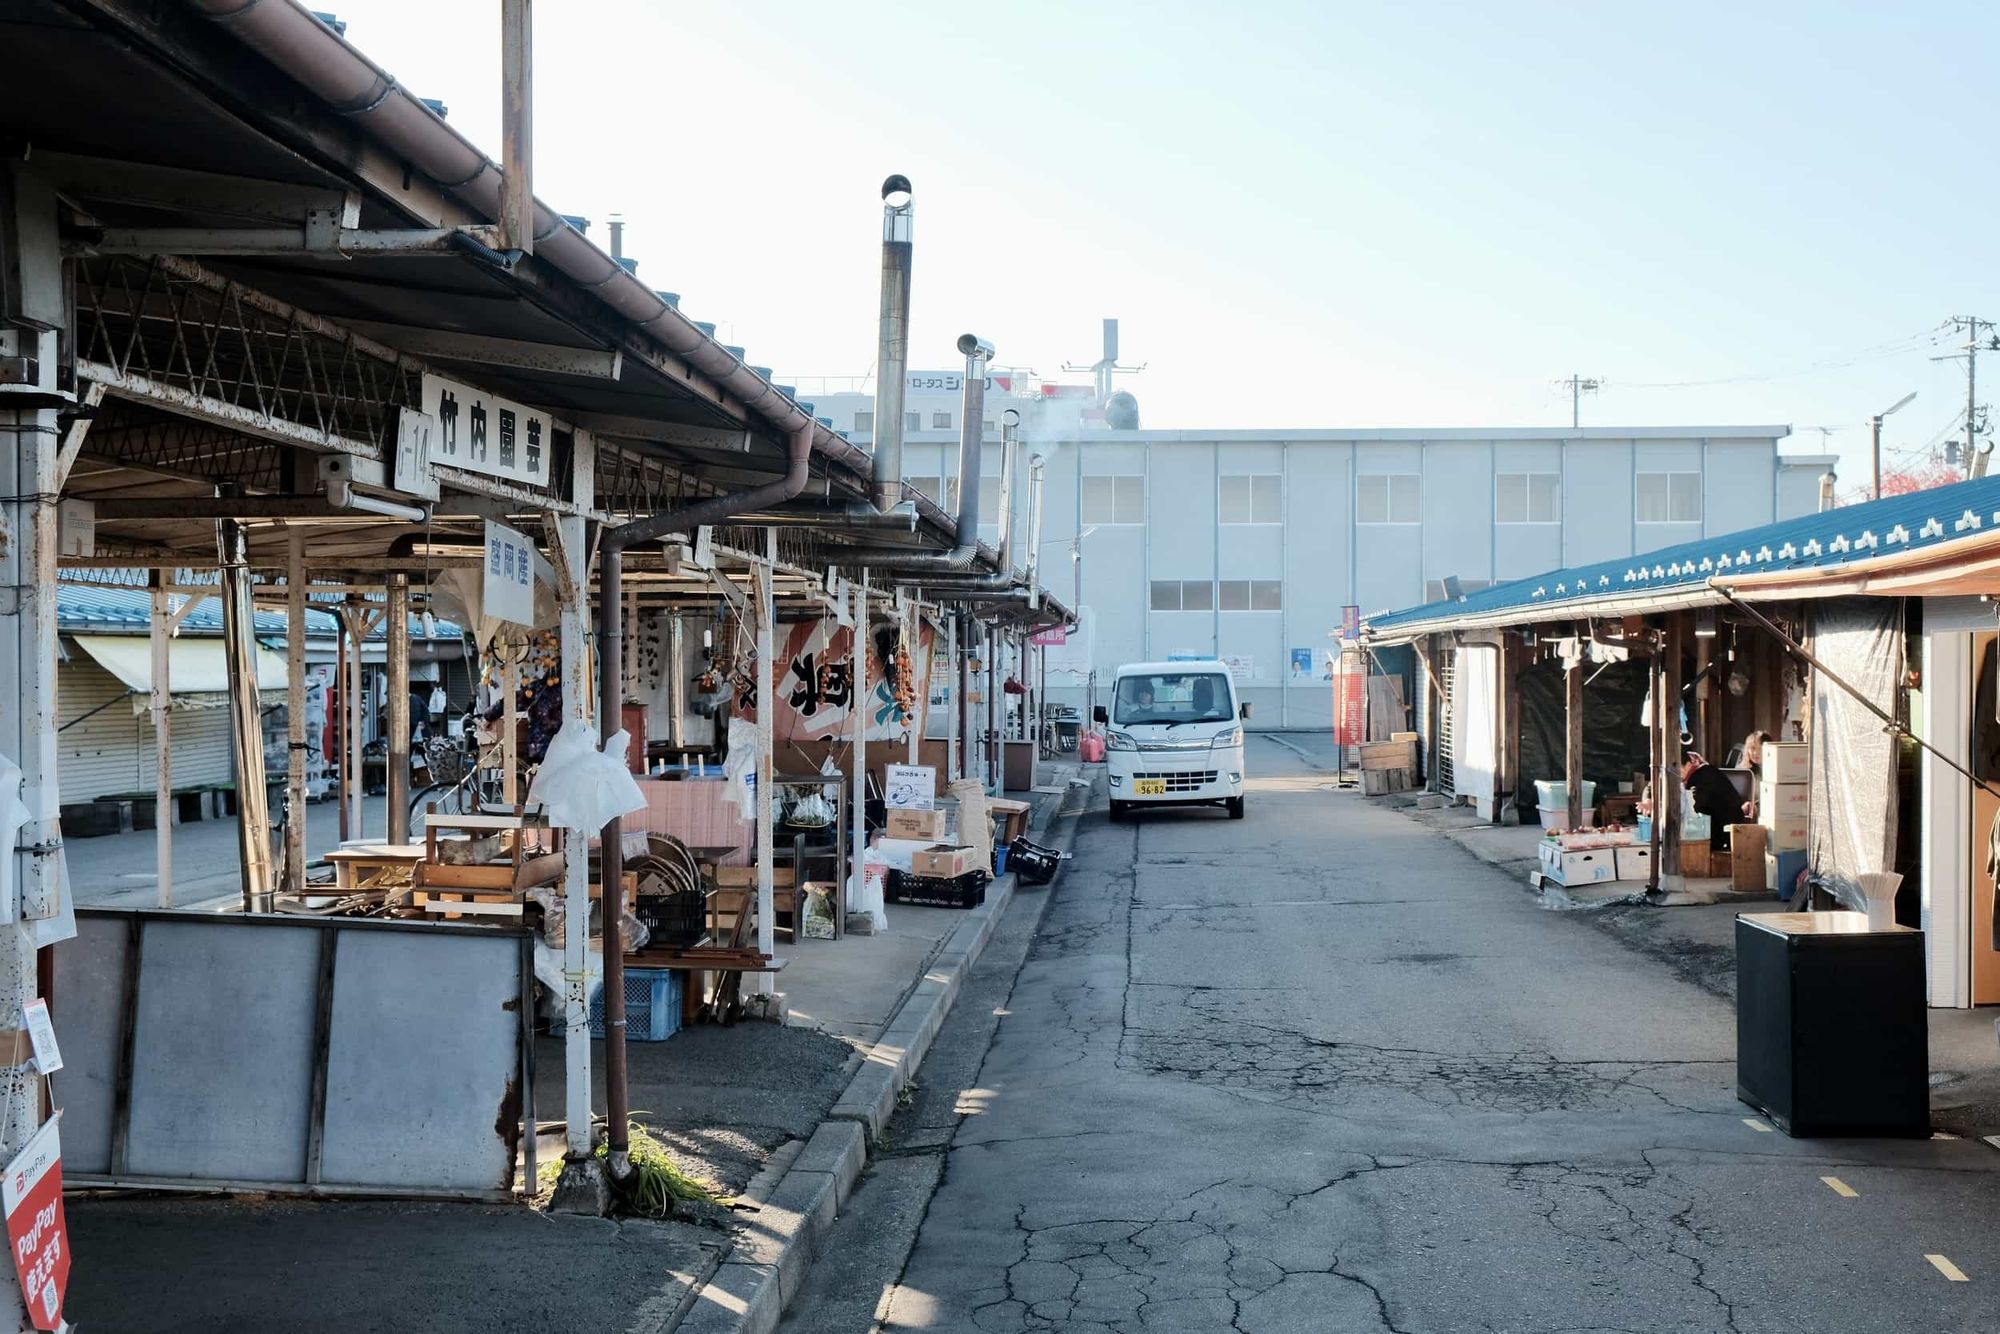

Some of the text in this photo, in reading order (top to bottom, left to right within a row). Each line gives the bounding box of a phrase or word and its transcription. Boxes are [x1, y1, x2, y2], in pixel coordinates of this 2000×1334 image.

[439, 388, 542, 475] 竹内園芸
[24, 1153, 47, 1182] PayPay
[17, 1197, 58, 1265] PayPay
[26, 1230, 61, 1304] 使えます
